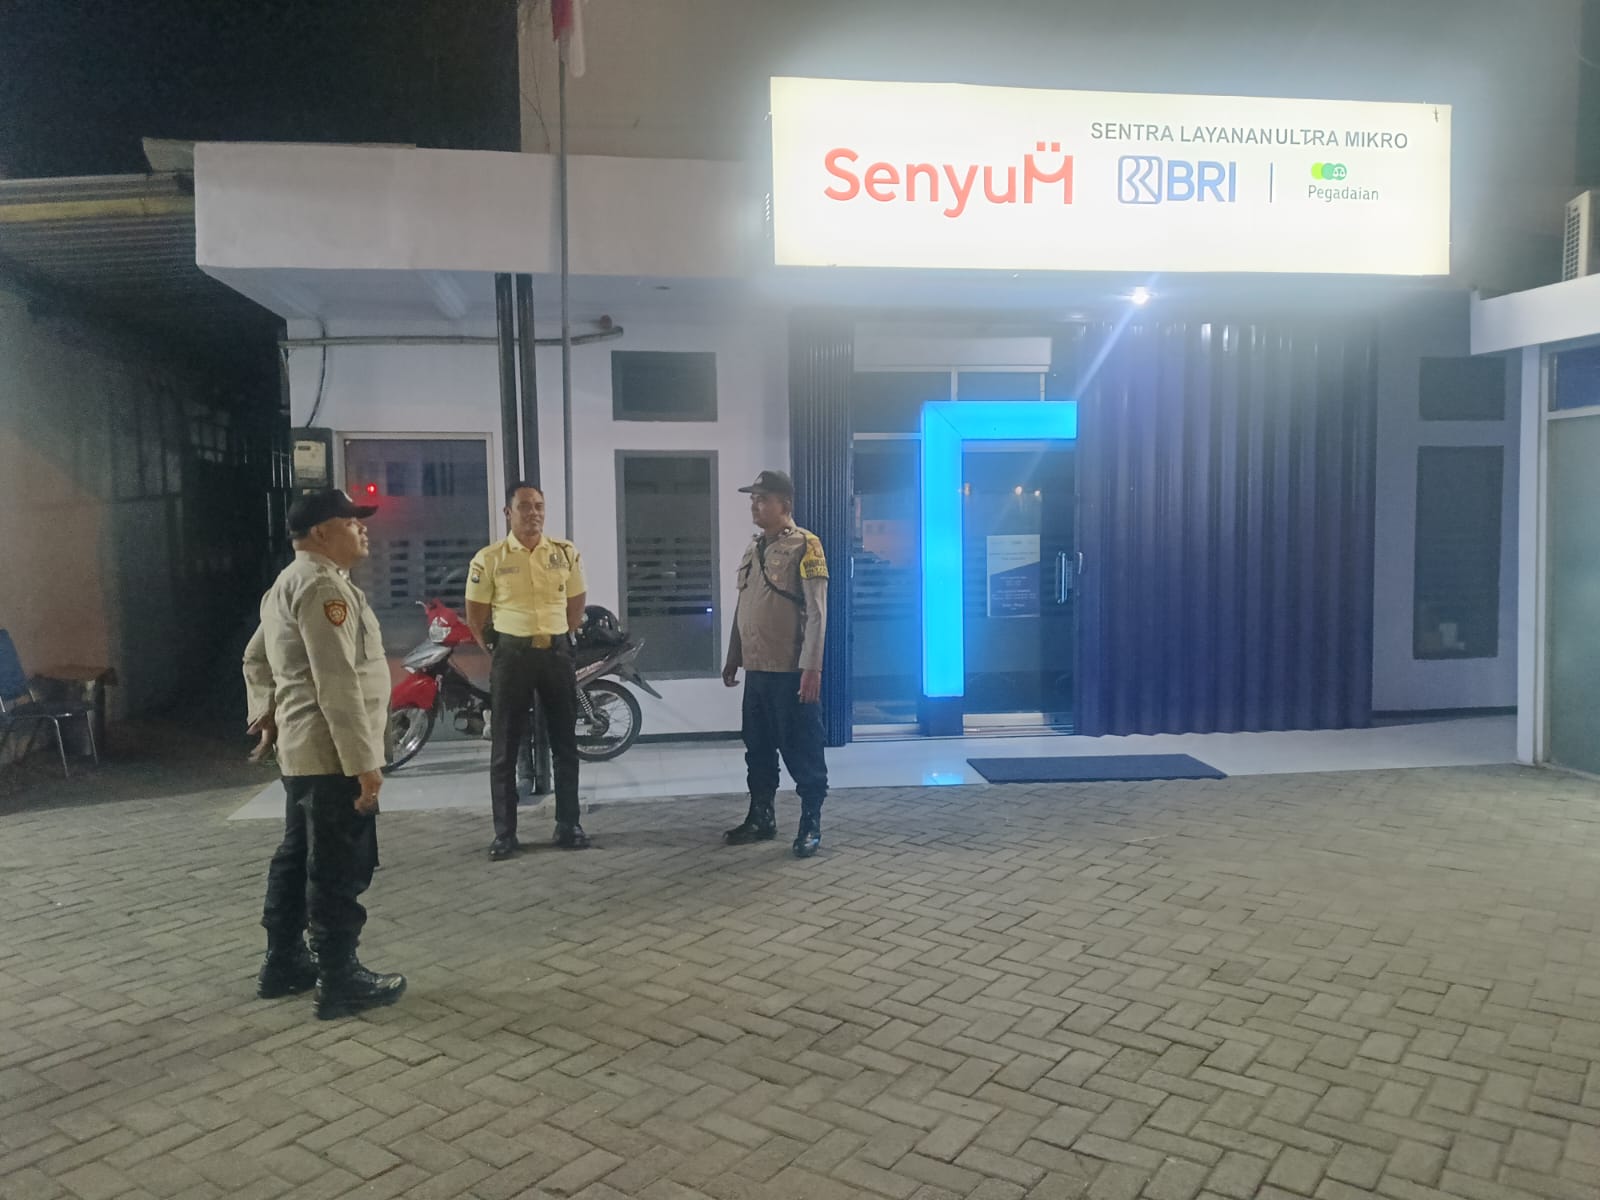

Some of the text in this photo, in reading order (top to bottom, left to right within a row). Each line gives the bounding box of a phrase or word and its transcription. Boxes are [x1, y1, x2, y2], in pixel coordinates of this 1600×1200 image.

[1091, 122, 1174, 142] SENTRA
[1345, 131, 1408, 149] MIKRO
[1167, 160, 1237, 202] BRI
[1307, 184, 1379, 203] Pegadaian
